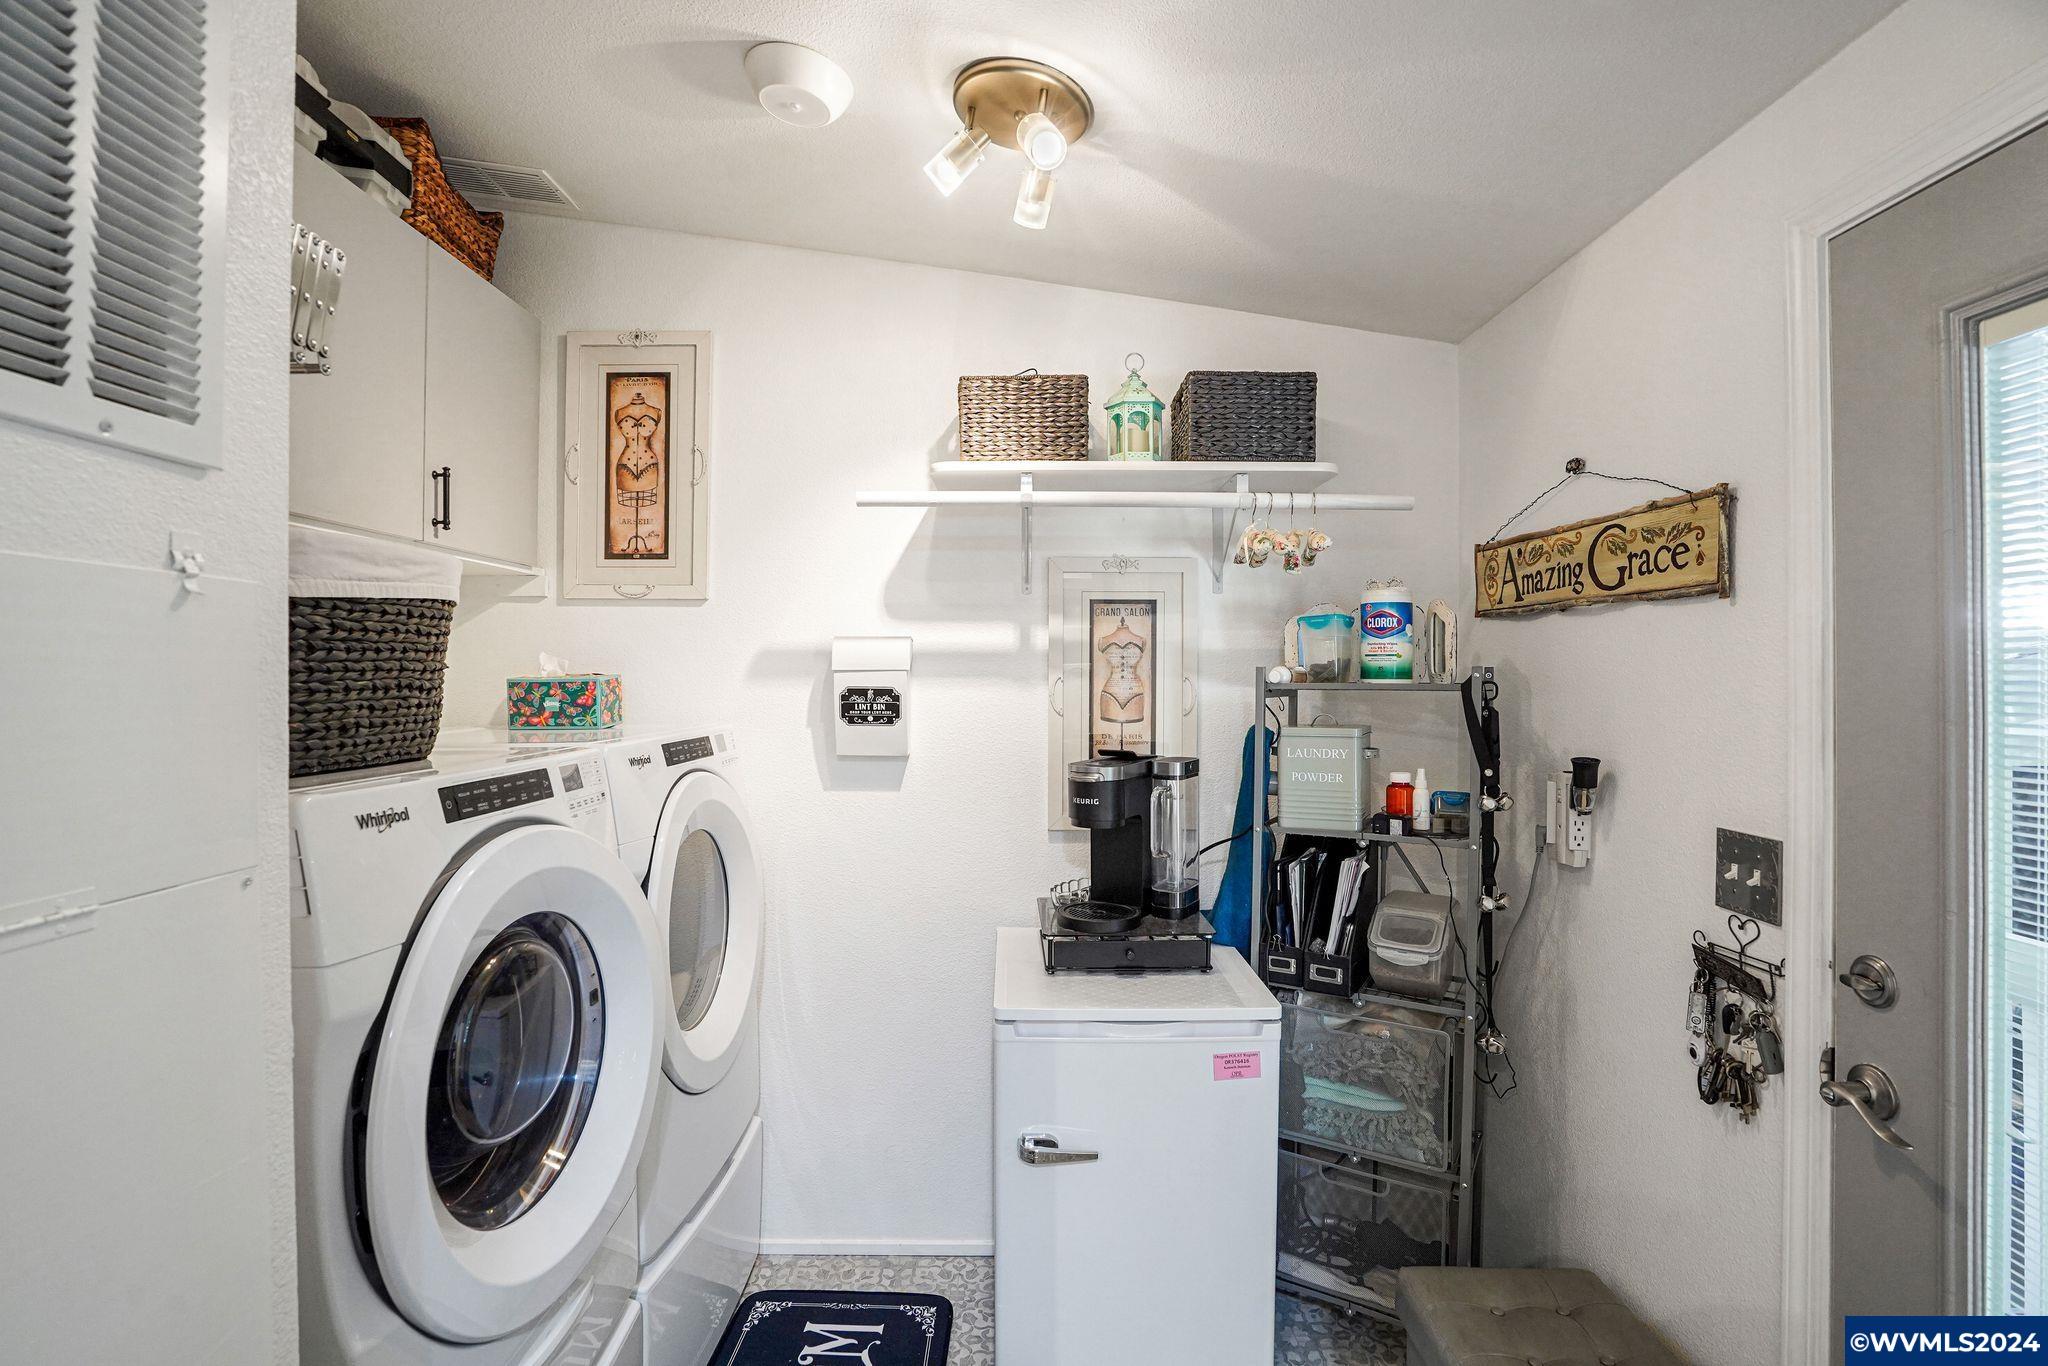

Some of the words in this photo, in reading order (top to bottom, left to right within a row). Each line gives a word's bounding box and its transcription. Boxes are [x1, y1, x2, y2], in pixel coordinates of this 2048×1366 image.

[1496, 547, 1584, 605] Amazing
[1587, 523, 1691, 592] Grace
[1095, 607, 1121, 617] GRAND
[1124, 607, 1151, 617] SALON
[1367, 617, 1399, 628] CLOROX
[854, 703, 871, 711] LINT
[872, 703, 886, 711] BIN
[1286, 747, 1349, 760] LAUNDRY
[1291, 771, 1344, 784] POWDER
[1072, 796, 1100, 805] KEURIG
[354, 806, 410, 834] Whirlpool
[797, 1320, 885, 1366] M
